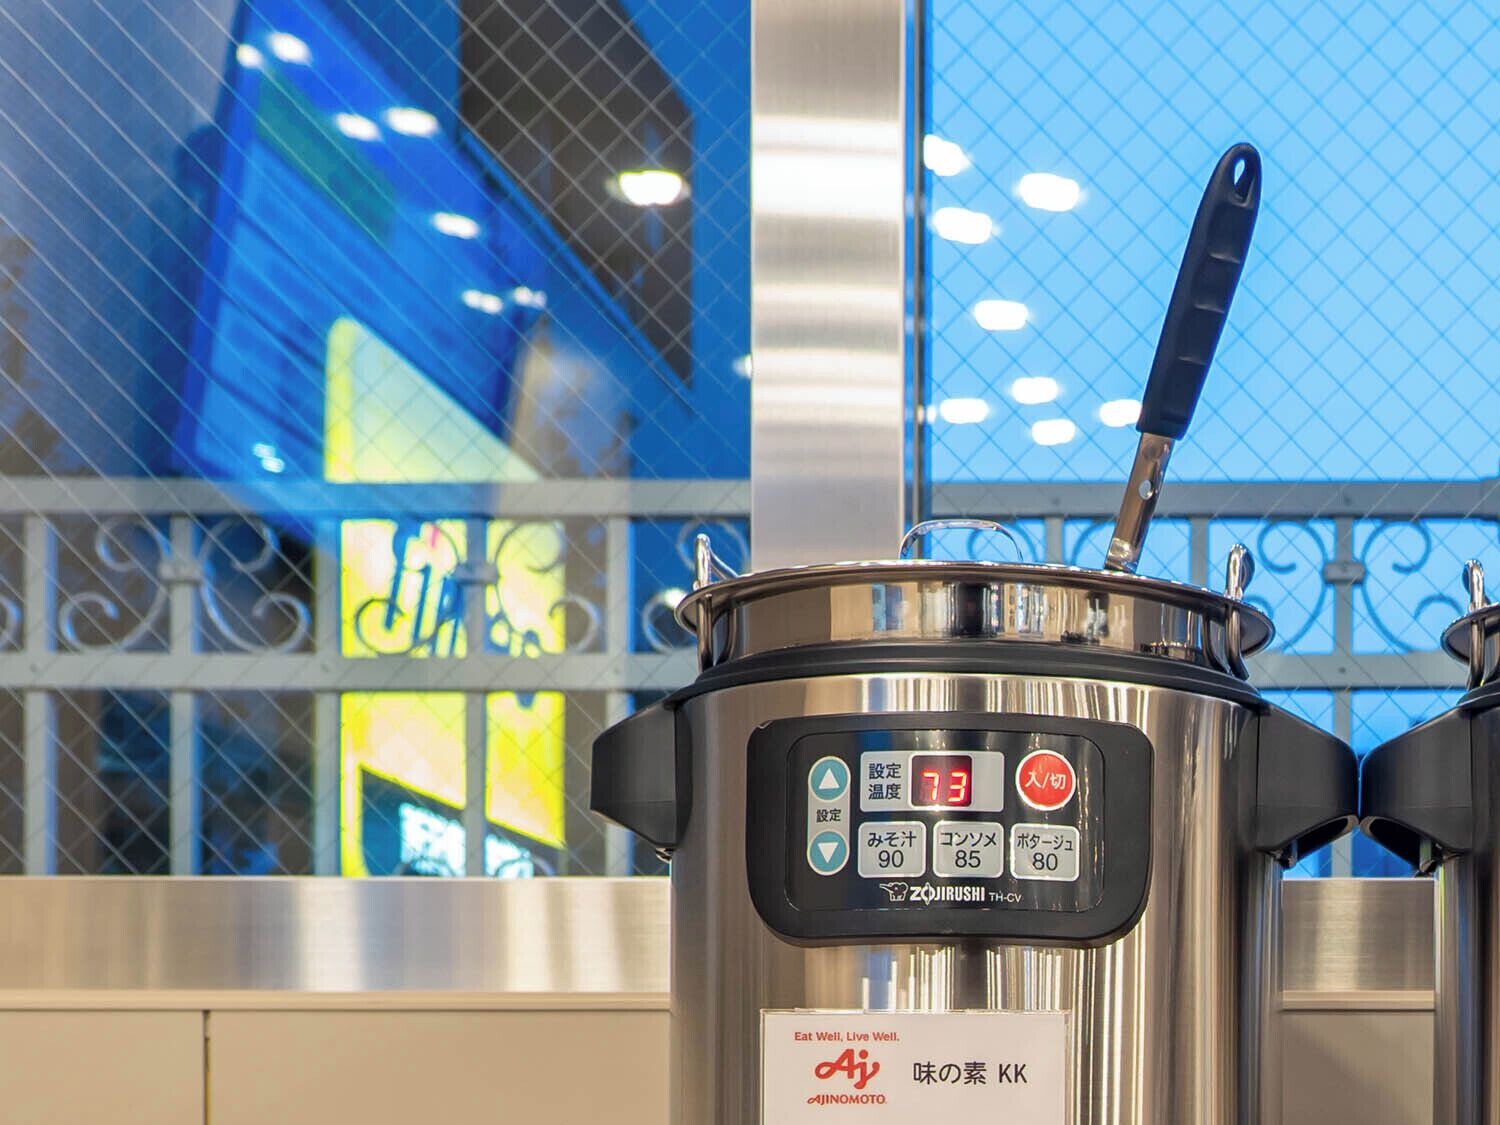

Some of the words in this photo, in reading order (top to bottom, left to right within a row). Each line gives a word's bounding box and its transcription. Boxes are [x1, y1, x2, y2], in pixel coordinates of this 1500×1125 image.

[868, 763, 902, 780] 設定
[1025, 769, 1067, 791] 入/切
[868, 783, 902, 801] 温度
[922, 770, 968, 803] 73
[816, 808, 842, 823] 設定
[867, 831, 917, 849] みそ汁
[940, 831, 998, 848] コンソメ
[1016, 833, 1075, 852] ポタージュ
[878, 850, 904, 869] 90
[954, 850, 981, 869] 85
[1032, 853, 1059, 872] 80
[909, 881, 986, 906] ZOJIRUSHI
[988, 892, 1022, 903] TH-CV
[794, 1031, 813, 1041] Eat
[816, 1031, 844, 1042] Well,
[846, 1031, 870, 1041] Live
[872, 1031, 900, 1042] Well.
[912, 1061, 988, 1086] 味の素
[998, 1063, 1028, 1084] KK
